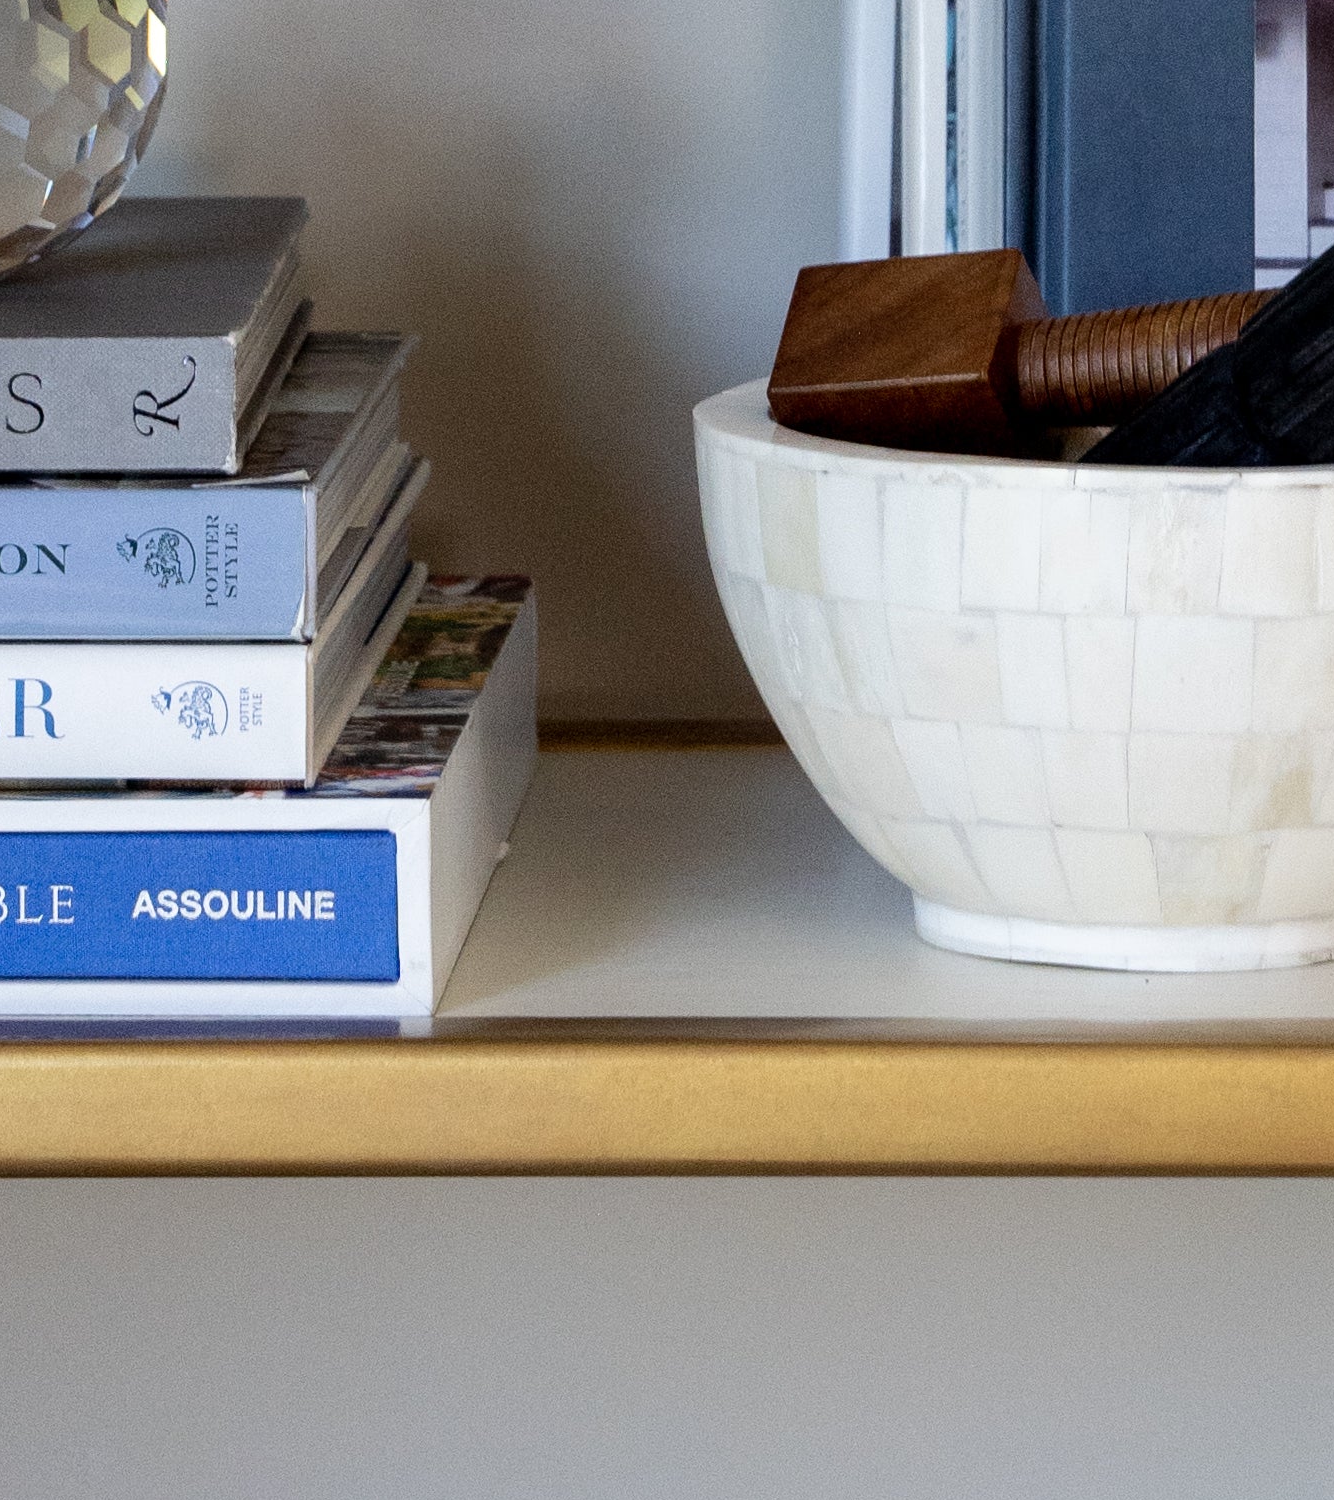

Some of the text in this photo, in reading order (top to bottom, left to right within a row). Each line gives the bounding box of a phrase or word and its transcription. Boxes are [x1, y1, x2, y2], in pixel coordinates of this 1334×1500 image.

[205, 514, 220, 608] POTTER
[225, 522, 239, 599] STYLE
[239, 686, 251, 733] POTTER
[251, 691, 263, 727] STYLE
[132, 889, 337, 922] ASSOULINE
